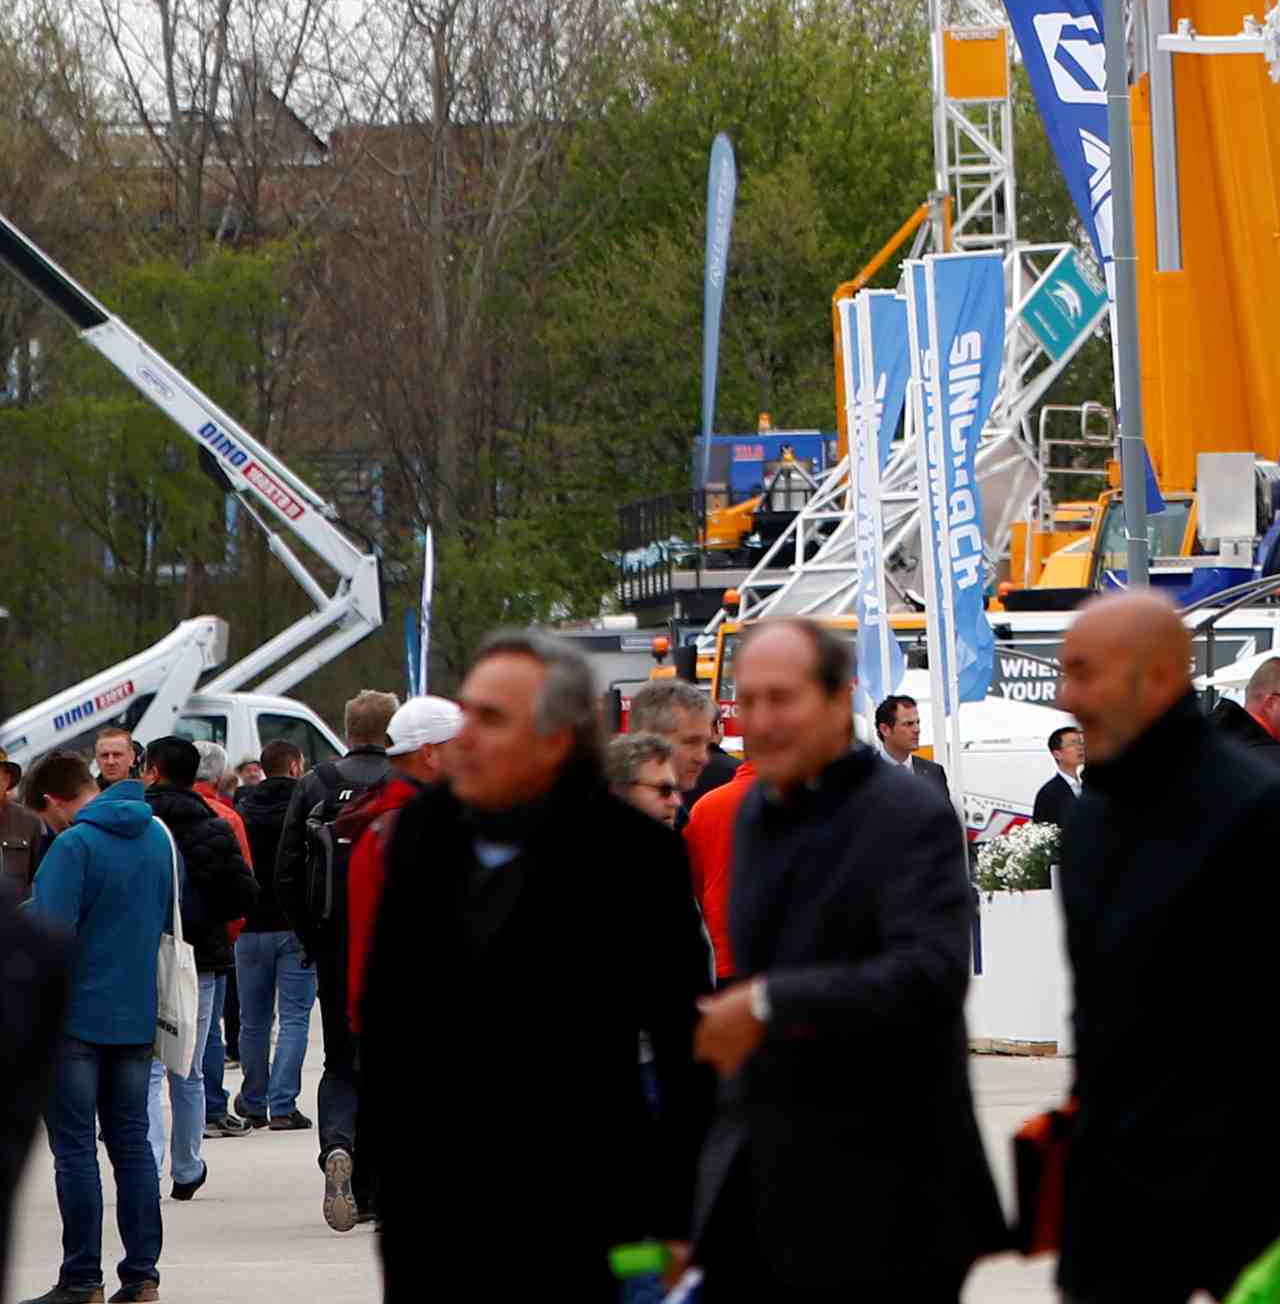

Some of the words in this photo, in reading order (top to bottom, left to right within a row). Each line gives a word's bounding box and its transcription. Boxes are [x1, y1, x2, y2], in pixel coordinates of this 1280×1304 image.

[198, 422, 248, 466] DINO
[1000, 682, 1056, 701] YOUR
[53, 699, 95, 730] DINO
